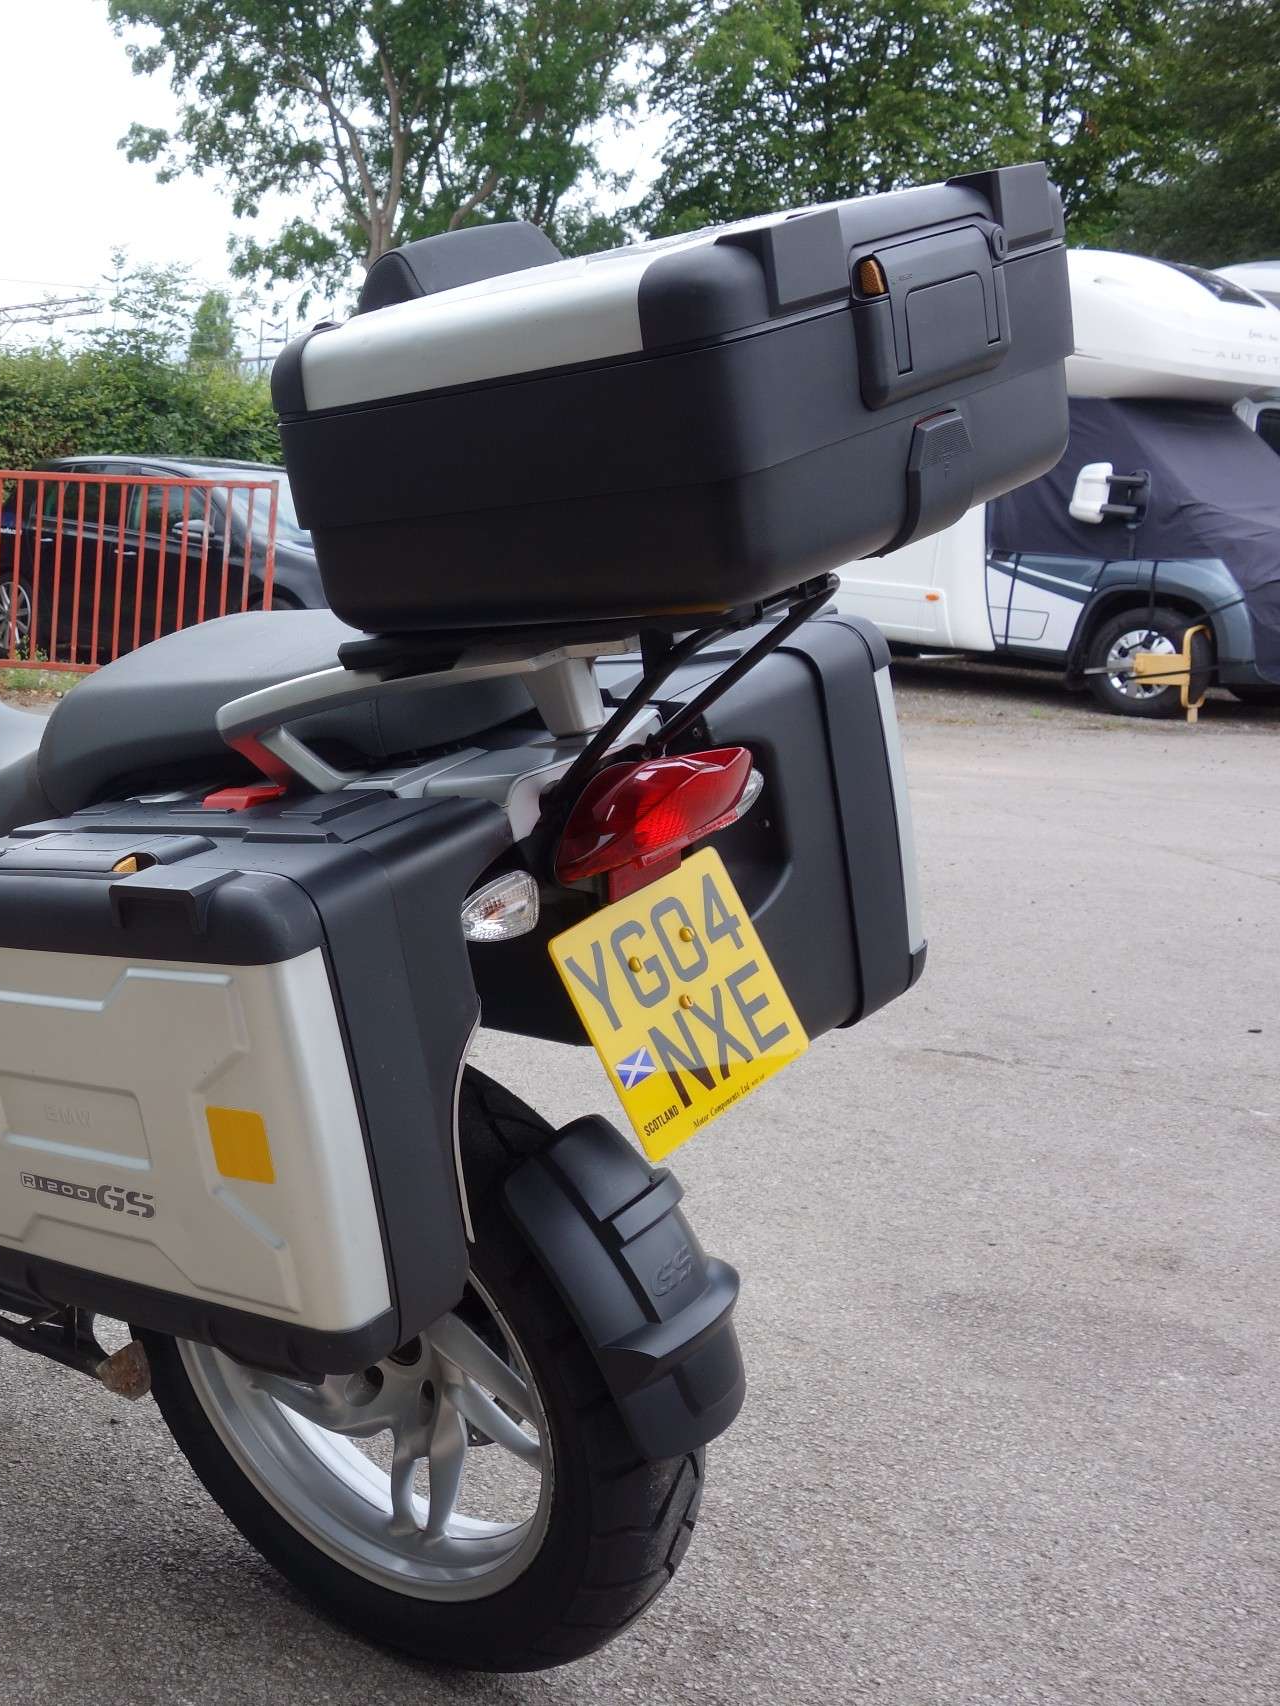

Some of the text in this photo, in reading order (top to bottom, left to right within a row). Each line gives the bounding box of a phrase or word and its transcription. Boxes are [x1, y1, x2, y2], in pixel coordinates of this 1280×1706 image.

[564, 873, 744, 1032] YG04
[647, 959, 790, 1109] NXE
[45, 1104, 90, 1127] BMW
[710, 1090, 740, 1116] Components
[643, 1104, 680, 1137] SCOTLAND
